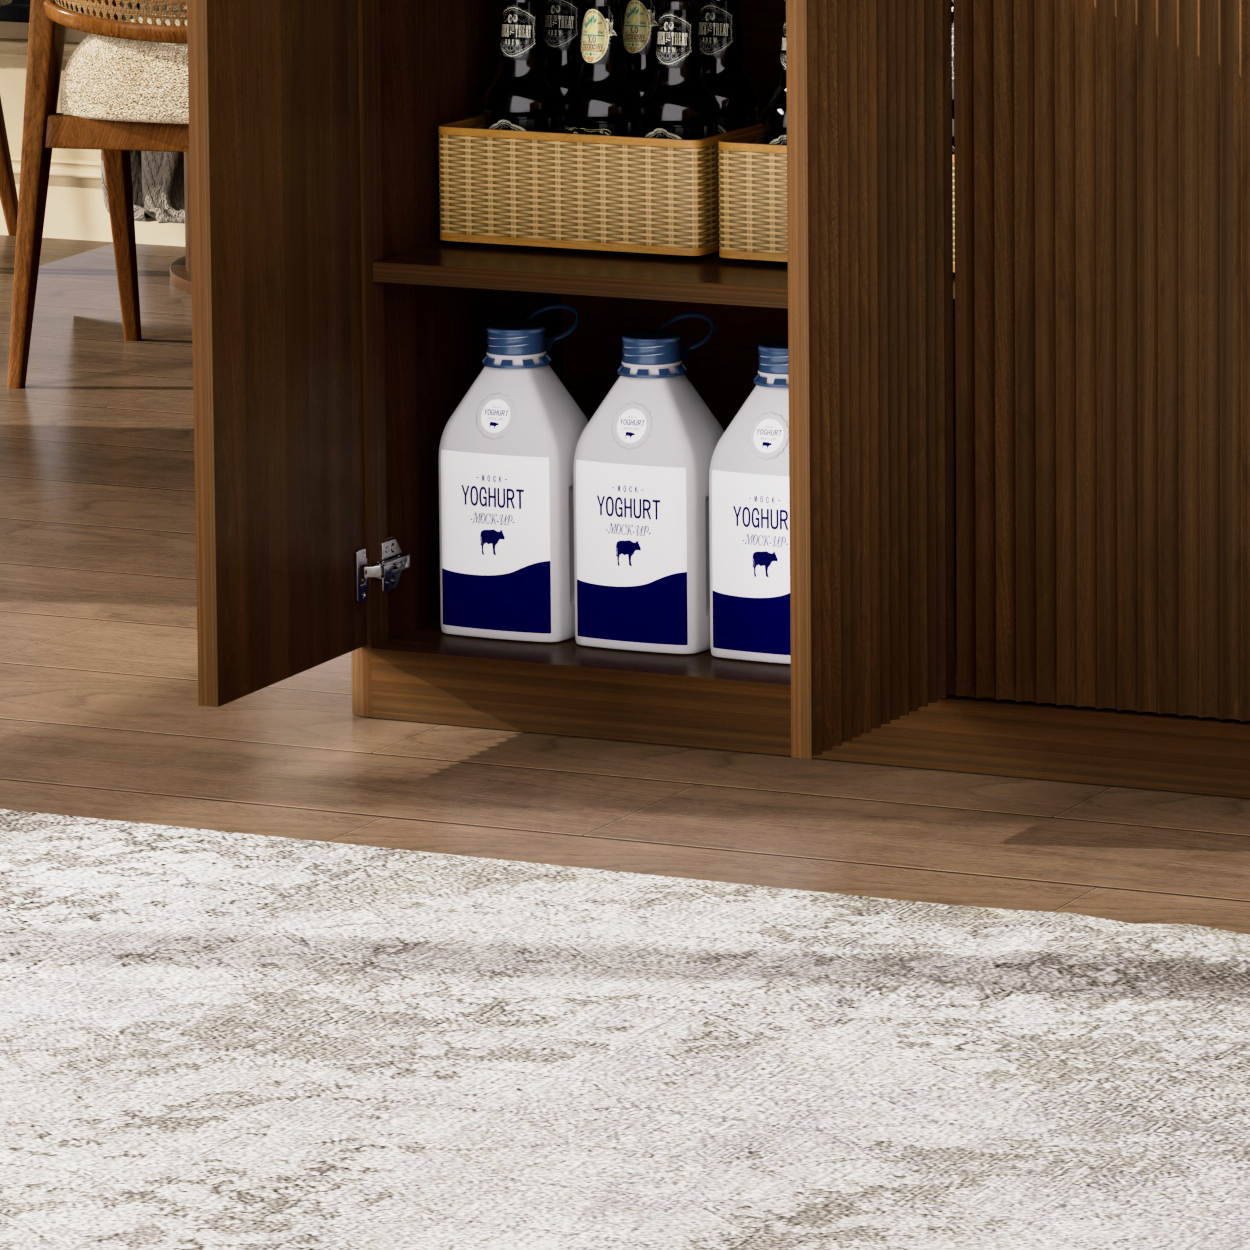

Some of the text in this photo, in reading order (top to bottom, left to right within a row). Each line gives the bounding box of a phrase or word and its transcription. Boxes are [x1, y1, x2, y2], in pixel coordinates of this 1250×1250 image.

[461, 485, 524, 509] YOGHURT
[597, 495, 660, 520] YOGHURT
[733, 506, 788, 530] YOGHUR
